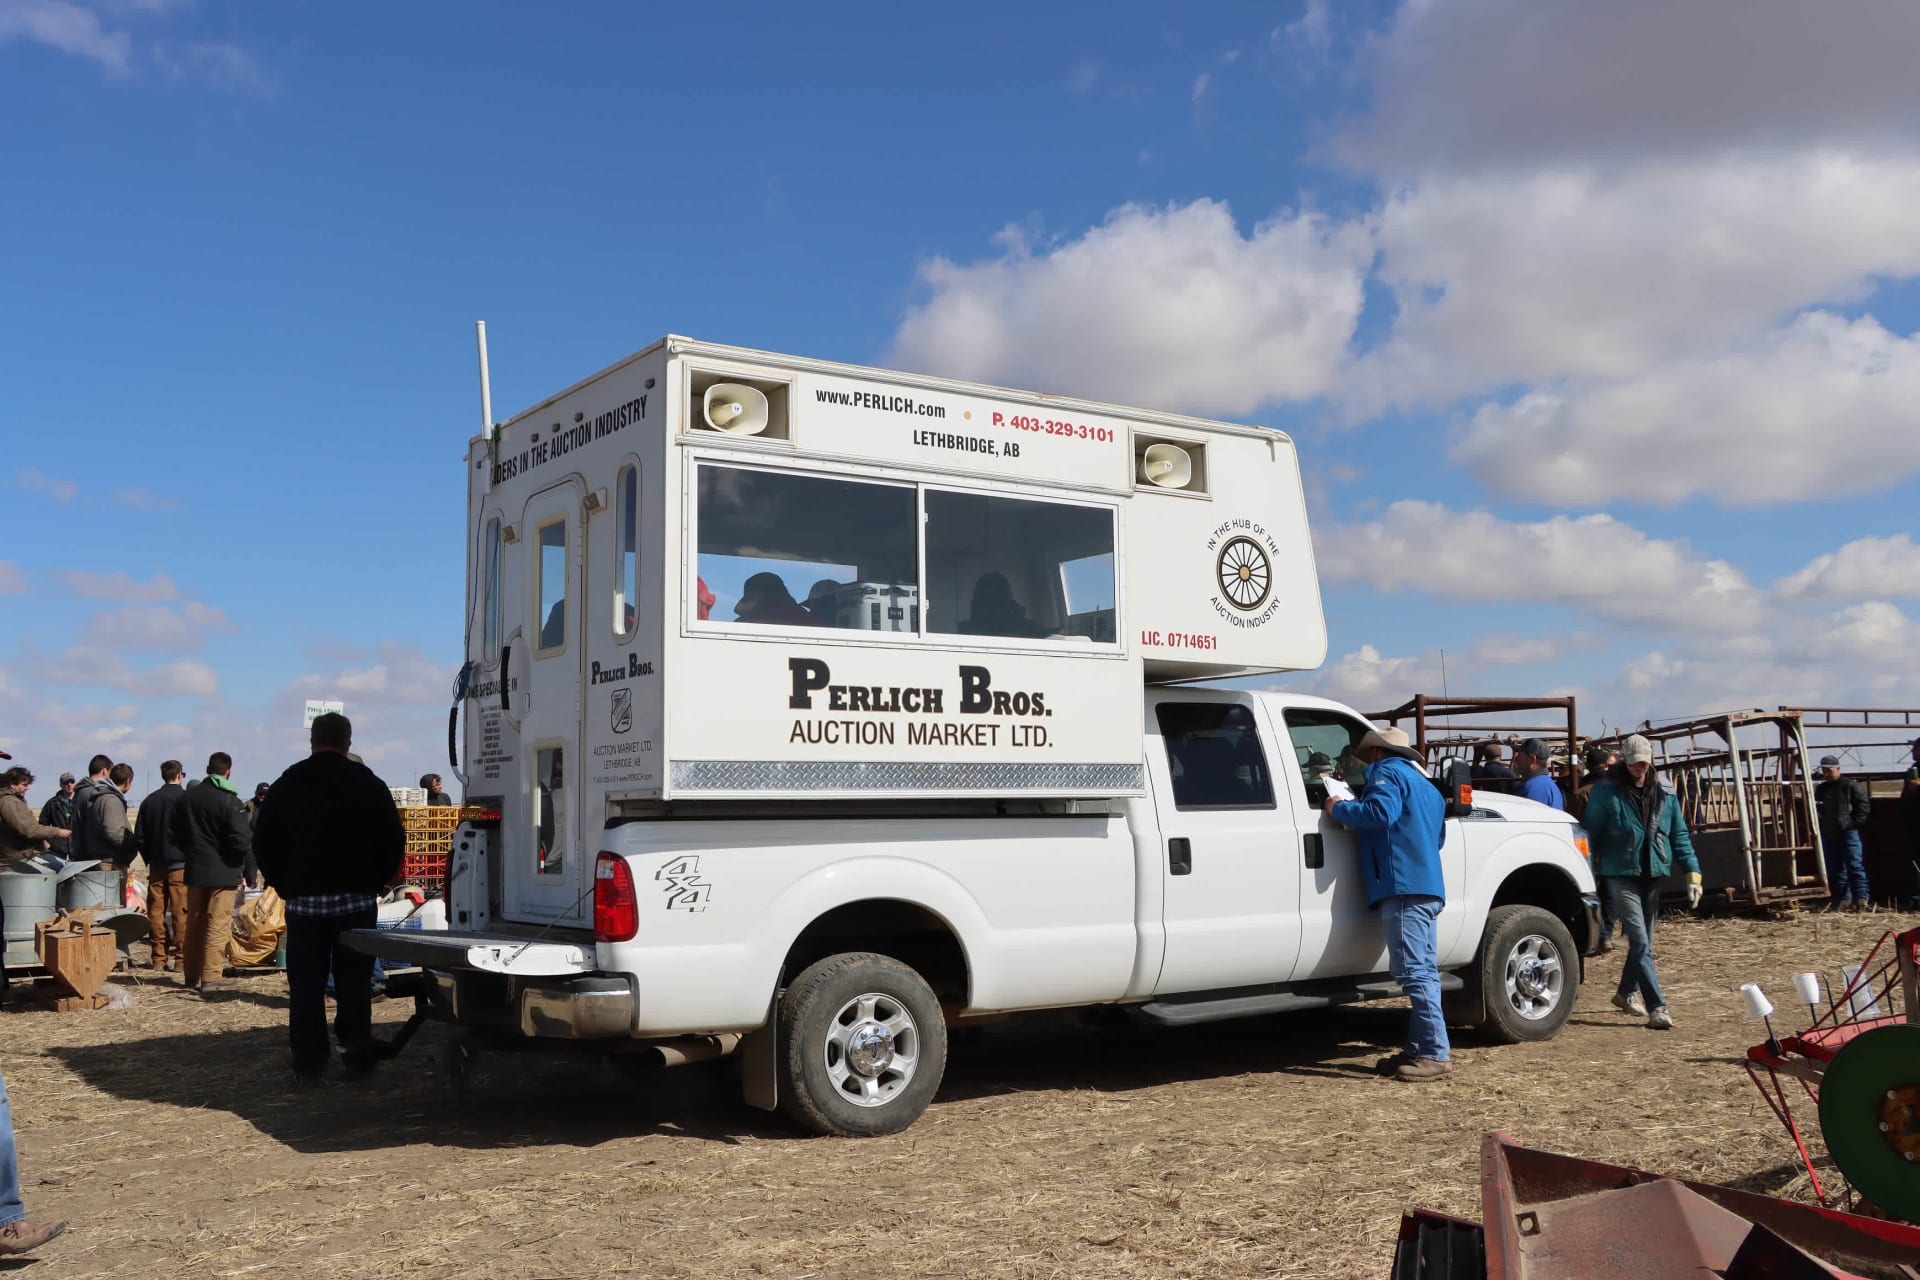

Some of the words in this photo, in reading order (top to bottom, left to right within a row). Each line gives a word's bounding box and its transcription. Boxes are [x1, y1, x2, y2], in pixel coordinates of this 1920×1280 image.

[816, 389, 946, 419] www.PERLICH.com
[520, 450, 529, 474] IN
[531, 442, 548, 469] THE
[550, 421, 592, 460] AUCTION
[595, 394, 648, 440] INDUSTRY
[992, 411, 1006, 428] P.
[1010, 414, 1115, 443] 403-329-3101
[912, 429, 1000, 457] LETHBRIDGE,
[1003, 441, 1021, 458] AB
[1207, 538, 1217, 551] IN
[1213, 521, 1232, 539] THE
[1232, 518, 1251, 530] HUB
[1253, 523, 1266, 536] OF
[1265, 534, 1280, 557] THE
[1210, 596, 1245, 629] AUCTION
[1246, 595, 1281, 629] INDUSTRY
[1141, 630, 1165, 647] LIC.
[1167, 632, 1218, 650] 0714651
[511, 677, 518, 692] IN
[789, 719, 895, 745] AUCTION
[907, 722, 1001, 746] MARKET
[1011, 724, 1054, 748] LTD.
